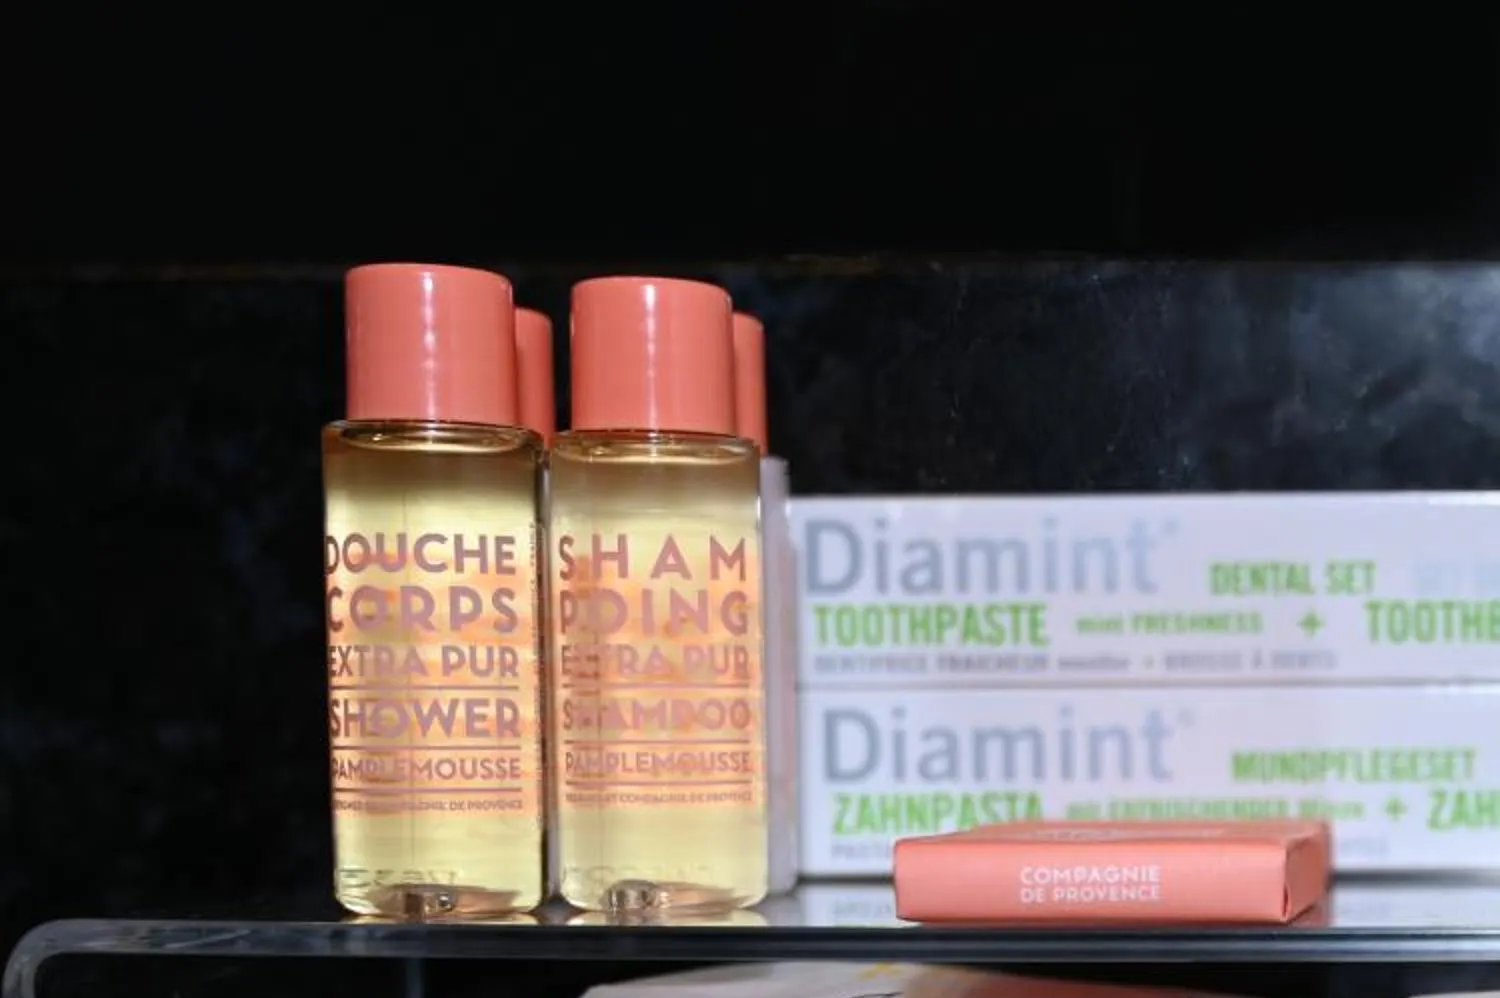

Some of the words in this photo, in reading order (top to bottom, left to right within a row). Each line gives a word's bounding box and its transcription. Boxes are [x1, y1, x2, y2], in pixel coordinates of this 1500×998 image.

[325, 532, 516, 575] DOUCHE
[559, 534, 746, 581] SHAM
[804, 516, 1158, 595] Diamint
[1208, 561, 1315, 595] DENTAL
[1324, 561, 1376, 595] SET
[327, 585, 518, 633] CORPS
[561, 589, 748, 636] POING
[813, 603, 1050, 646] TOOTHPASTE
[328, 645, 428, 677] EXTRA
[441, 645, 518, 677] PUR
[683, 644, 750, 680] PUR
[331, 698, 520, 738] SHOWER
[563, 698, 751, 731] SAMPOO
[823, 706, 1172, 783] Diamint
[832, 792, 1043, 834] ZAHNPASTA
[1020, 865, 1161, 884] COMPAGNIE
[1021, 887, 1046, 903] DE
[1054, 885, 1160, 903] PROVENCE
